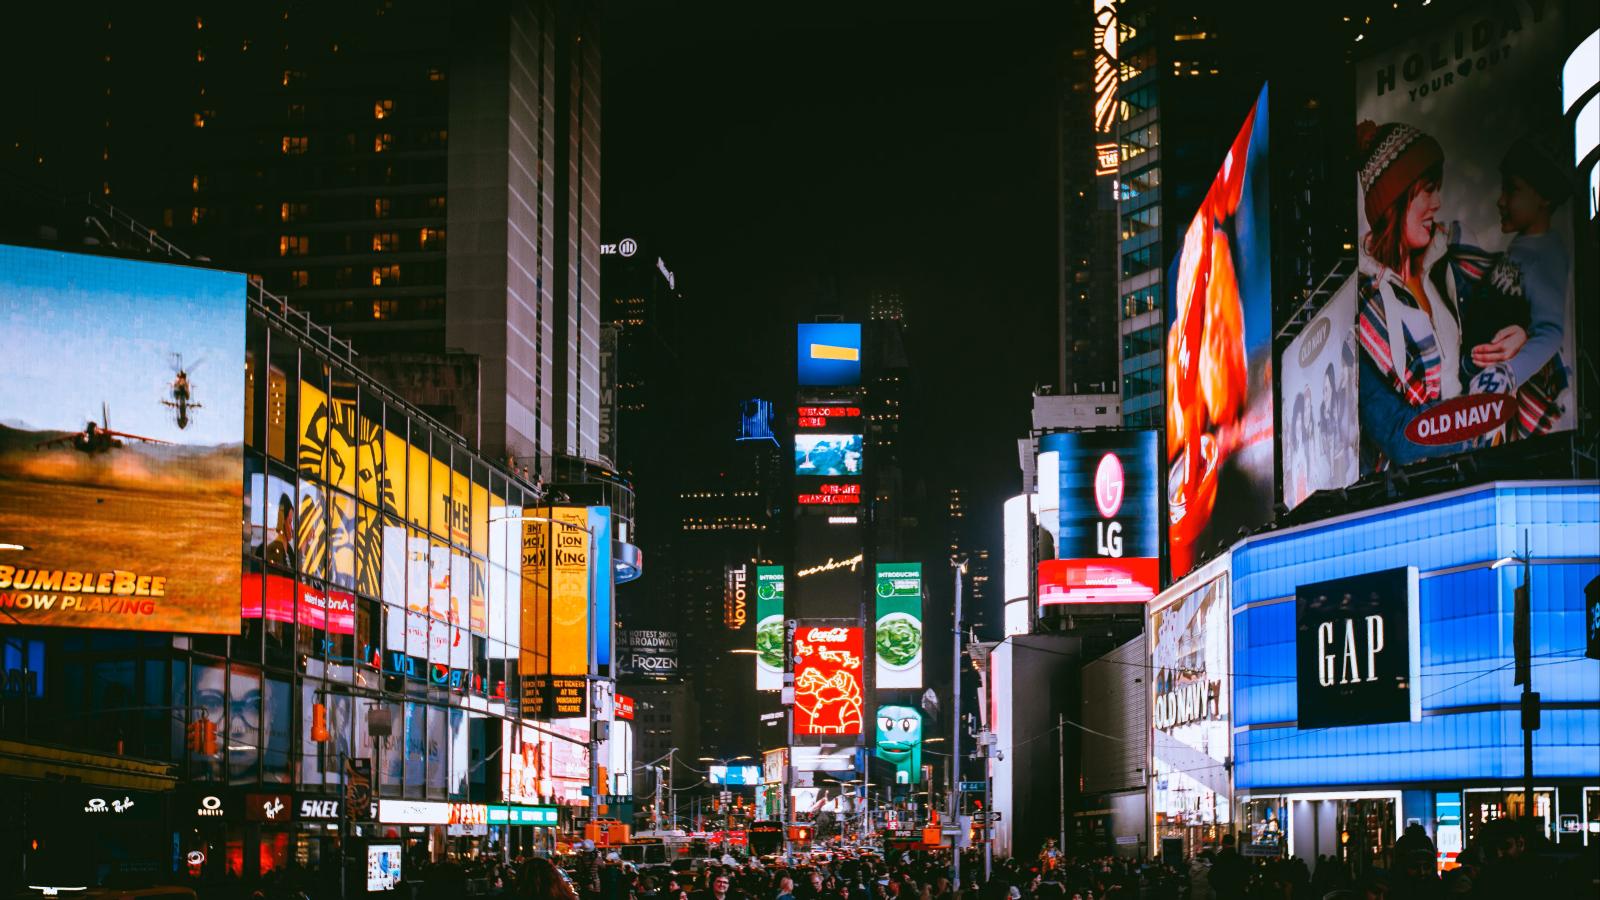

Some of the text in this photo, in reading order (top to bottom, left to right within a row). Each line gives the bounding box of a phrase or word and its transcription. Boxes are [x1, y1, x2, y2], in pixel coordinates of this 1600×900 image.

[1377, 0, 1547, 96] HOLIDAY
[1408, 44, 1511, 101] YOUR OUT
[599, 352, 612, 444] TIMES
[1417, 400, 1505, 438] OLD NAVY
[442, 493, 469, 533] THE
[560, 523, 578, 531] THE
[555, 549, 586, 566] KING
[557, 533, 582, 547] LION
[1097, 521, 1123, 558] LG
[0, 564, 167, 597] BUMBLEBEE
[734, 564, 746, 629] NOVOTEL
[0, 593, 156, 616] NOW PLAYING
[630, 630, 657, 638] HOTTEST
[1318, 614, 1385, 688] GAP
[631, 654, 678, 671] FROZEN
[1155, 680, 1209, 730] OLD NAVY
